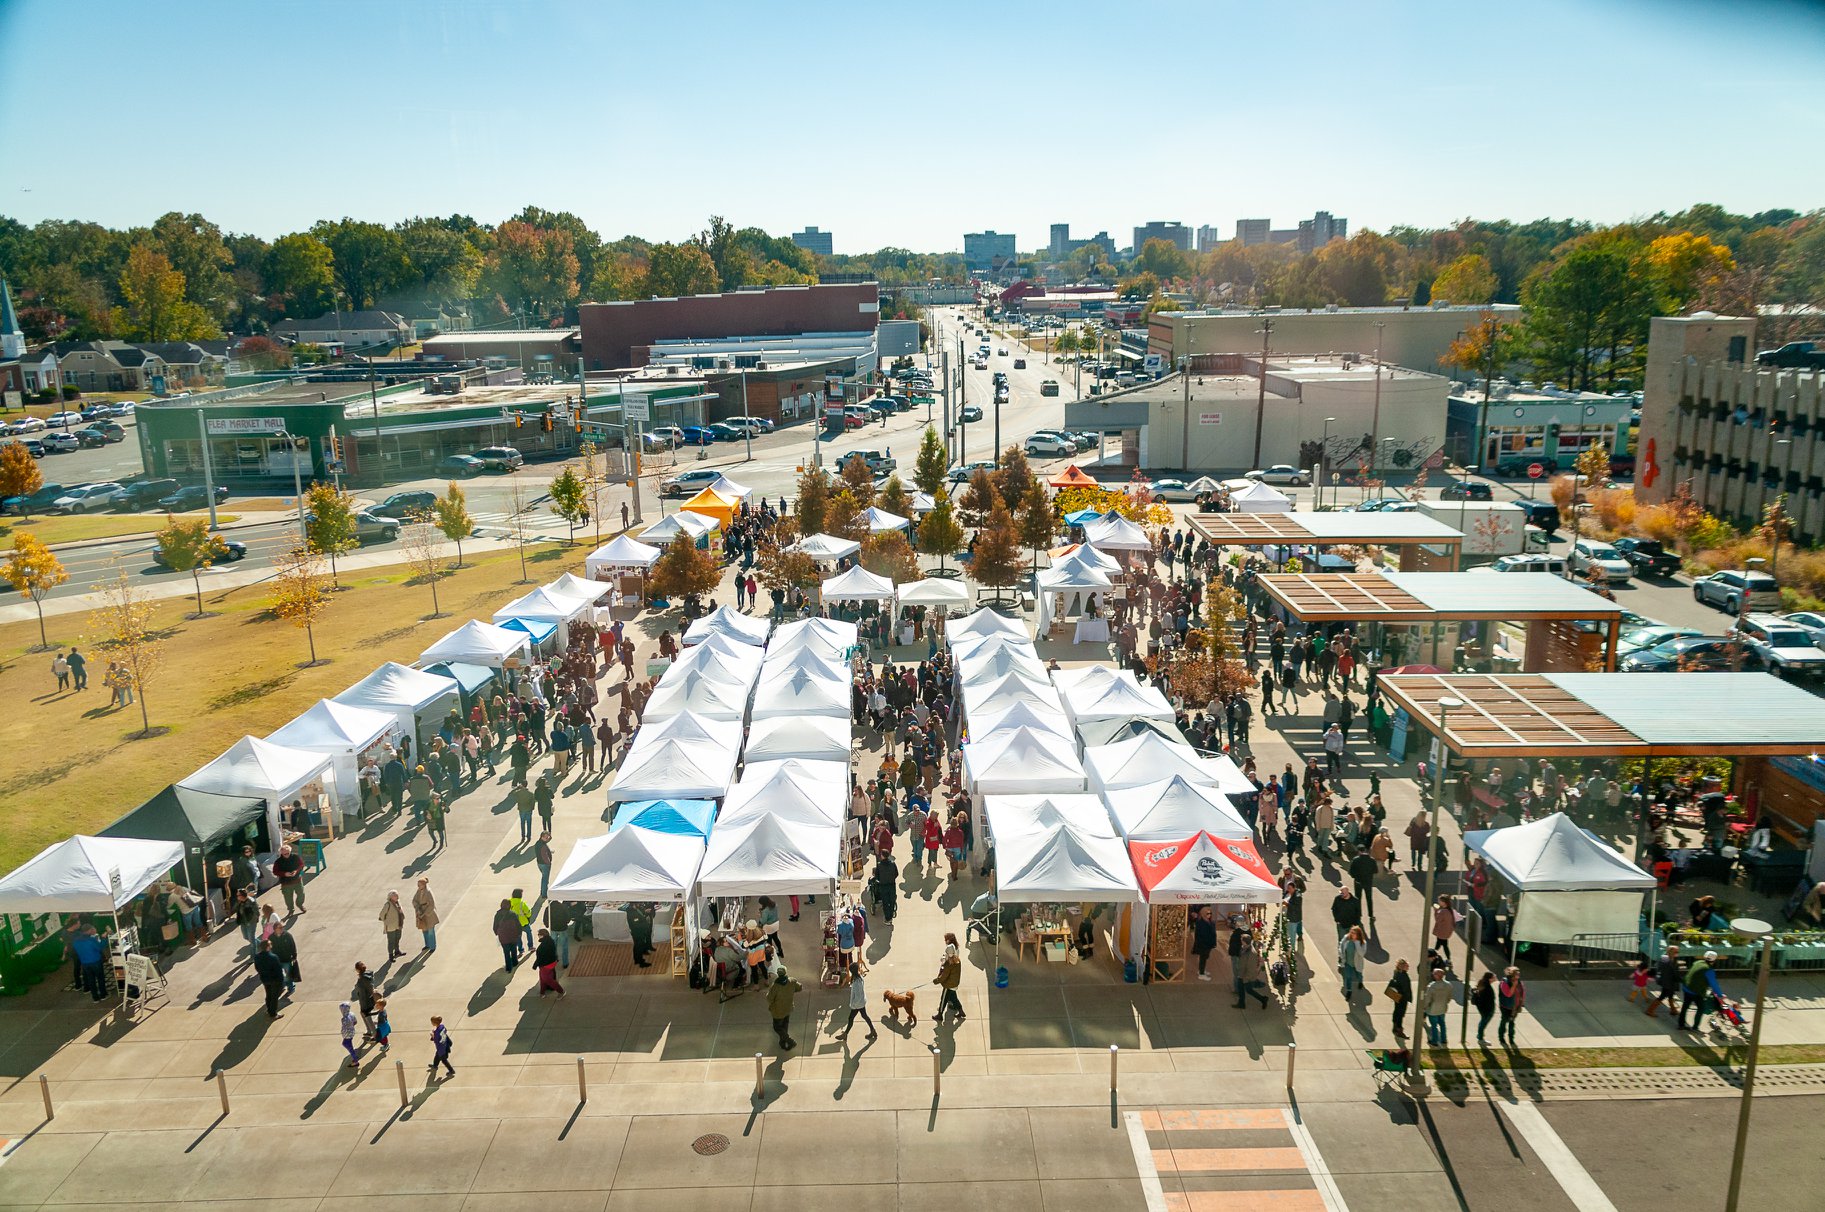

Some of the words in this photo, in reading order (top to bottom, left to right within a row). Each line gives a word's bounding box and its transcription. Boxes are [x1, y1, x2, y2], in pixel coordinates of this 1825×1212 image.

[208, 420, 226, 429] FLEA
[229, 419, 260, 429] MARKET
[264, 418, 284, 428] MALL
[1645, 461, 1650, 476] P
